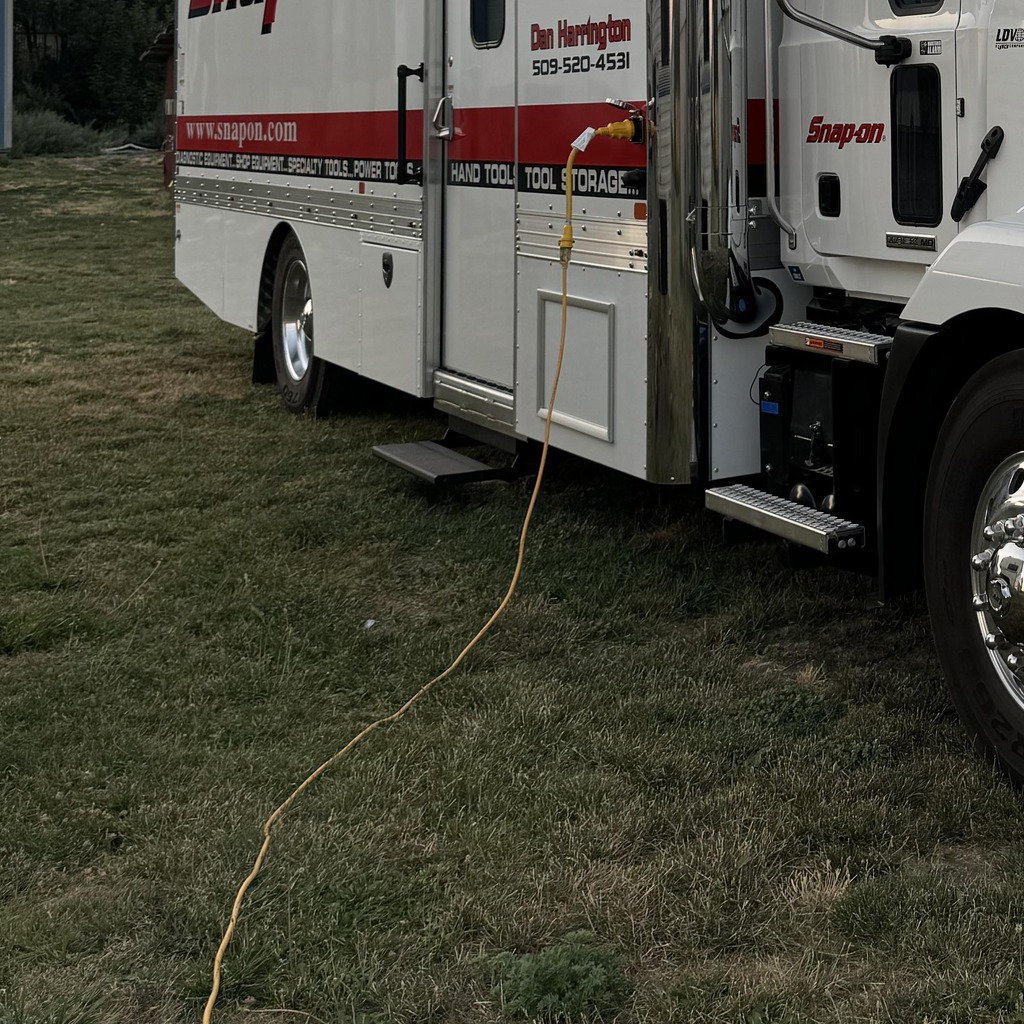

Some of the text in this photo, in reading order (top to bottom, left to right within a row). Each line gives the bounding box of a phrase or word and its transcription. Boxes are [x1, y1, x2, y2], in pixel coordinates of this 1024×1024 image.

[530, 14, 631, 51] Dan Harrington
[995, 28, 1018, 42] LDV
[532, 51, 630, 76] 509-520-4531
[186, 120, 298, 148] www.snapon.com
[806, 116, 886, 150] Snap-on
[288, 157, 323, 175] SPECIALTY
[353, 160, 382, 179] POWER
[450, 162, 481, 184] HAND
[524, 166, 557, 190] TOOL
